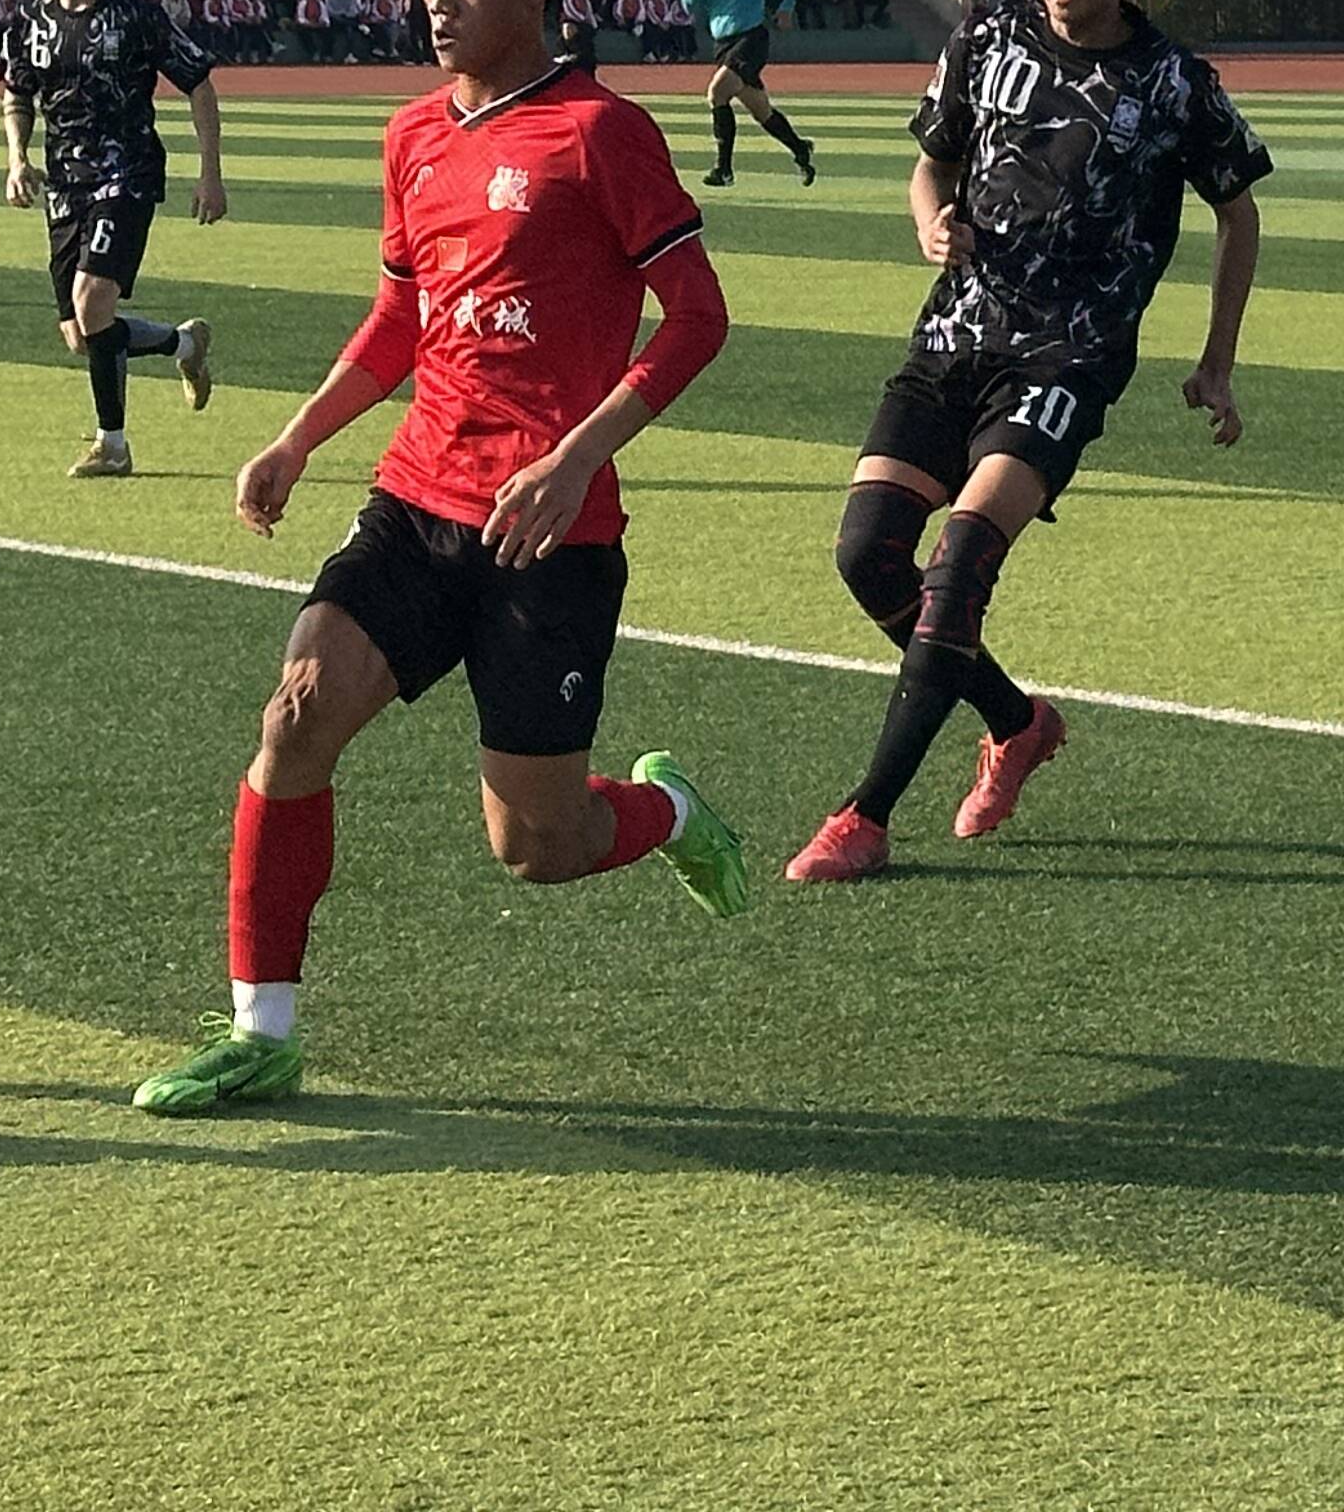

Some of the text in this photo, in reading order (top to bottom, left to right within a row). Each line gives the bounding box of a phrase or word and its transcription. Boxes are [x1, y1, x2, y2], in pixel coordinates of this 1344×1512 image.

[978, 49, 1041, 116] 10
[89, 218, 115, 254] 6
[1007, 385, 1077, 441] 10
